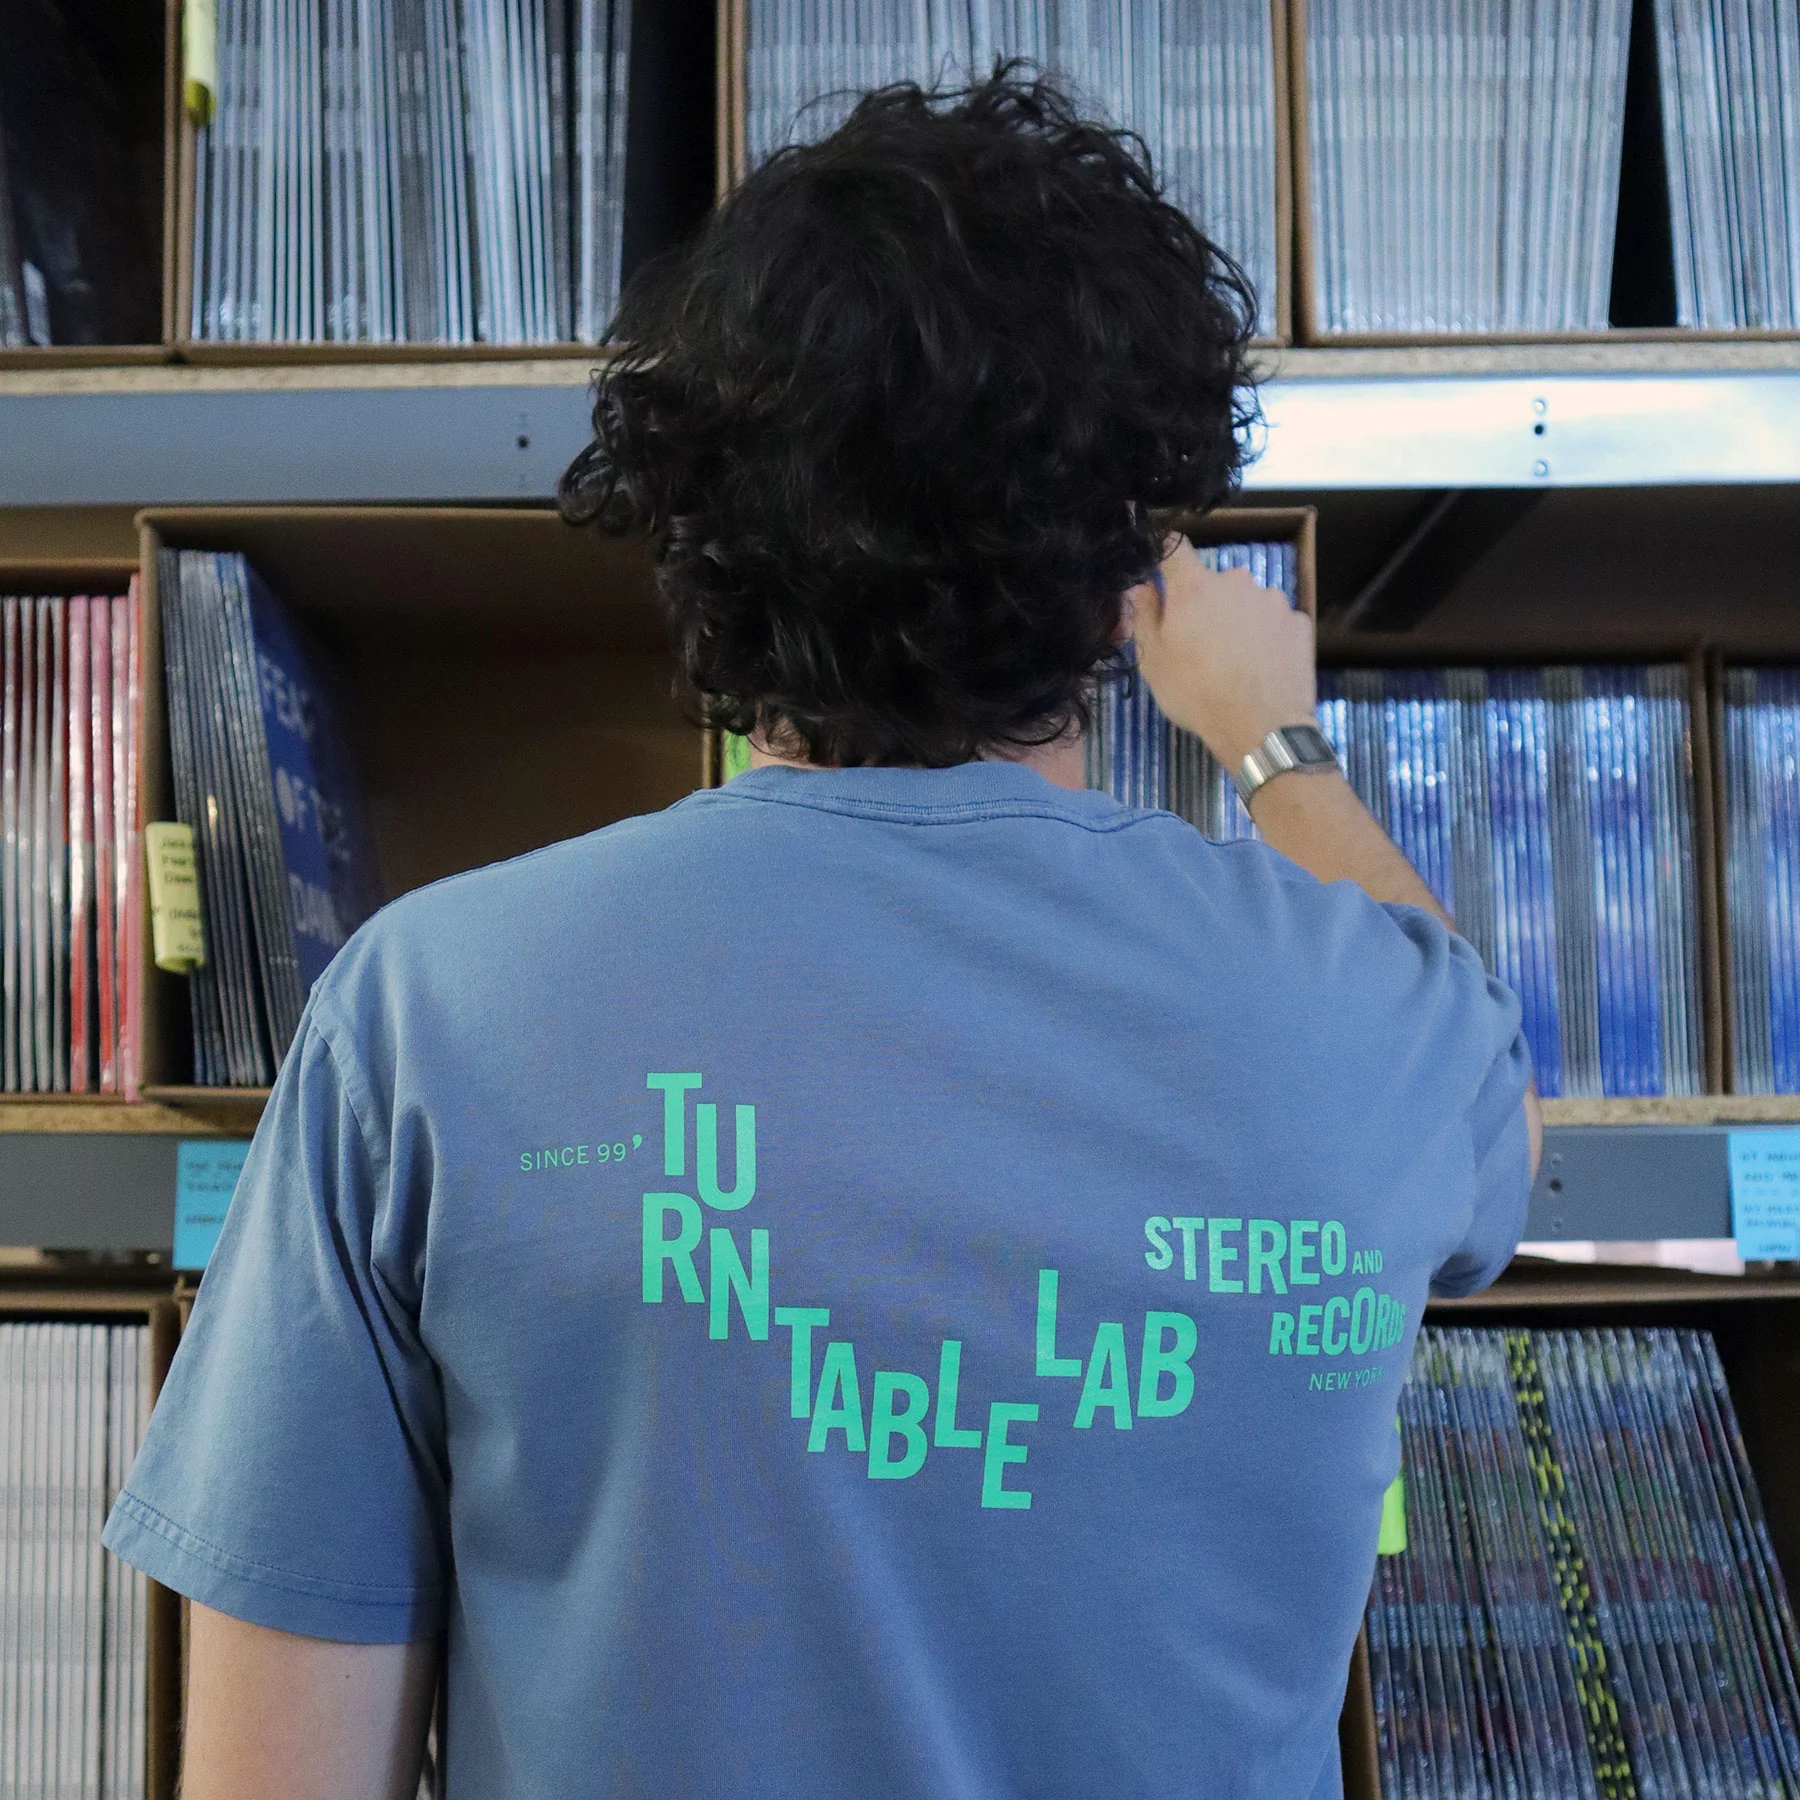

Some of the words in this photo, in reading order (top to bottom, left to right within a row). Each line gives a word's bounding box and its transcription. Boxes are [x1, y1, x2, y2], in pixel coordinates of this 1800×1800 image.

[520, 1145, 589, 1172] SINCE
[1144, 1215, 1347, 1294] STEREO
[1351, 1249, 1384, 1276] AND
[1035, 1268, 1198, 1430] LAB
[1308, 1371, 1351, 1392] NEW
